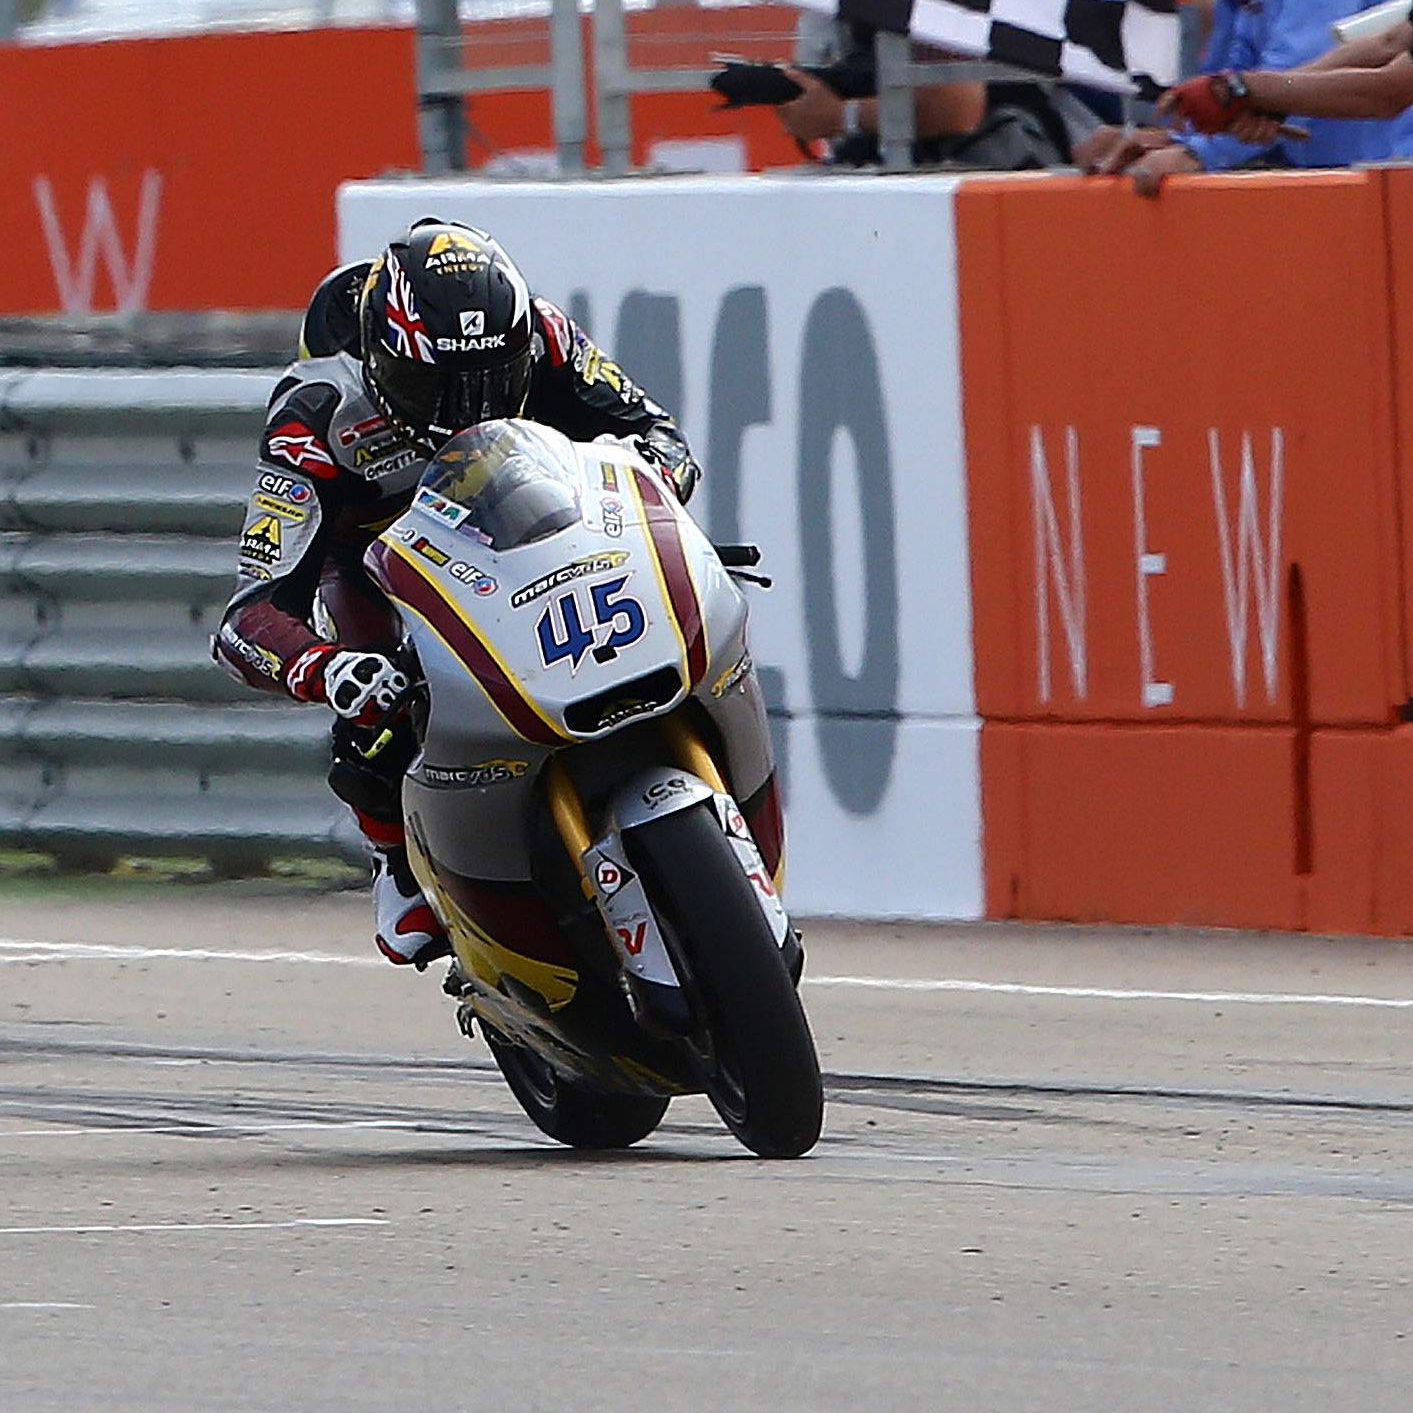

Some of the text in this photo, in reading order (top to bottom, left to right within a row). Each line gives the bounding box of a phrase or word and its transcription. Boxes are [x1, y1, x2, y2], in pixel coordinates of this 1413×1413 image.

[436, 333, 506, 352] SHARK
[261, 473, 294, 496] elf
[451, 562, 483, 586] elf
[1030, 424, 1286, 710] NEW
[534, 572, 647, 676] 45
